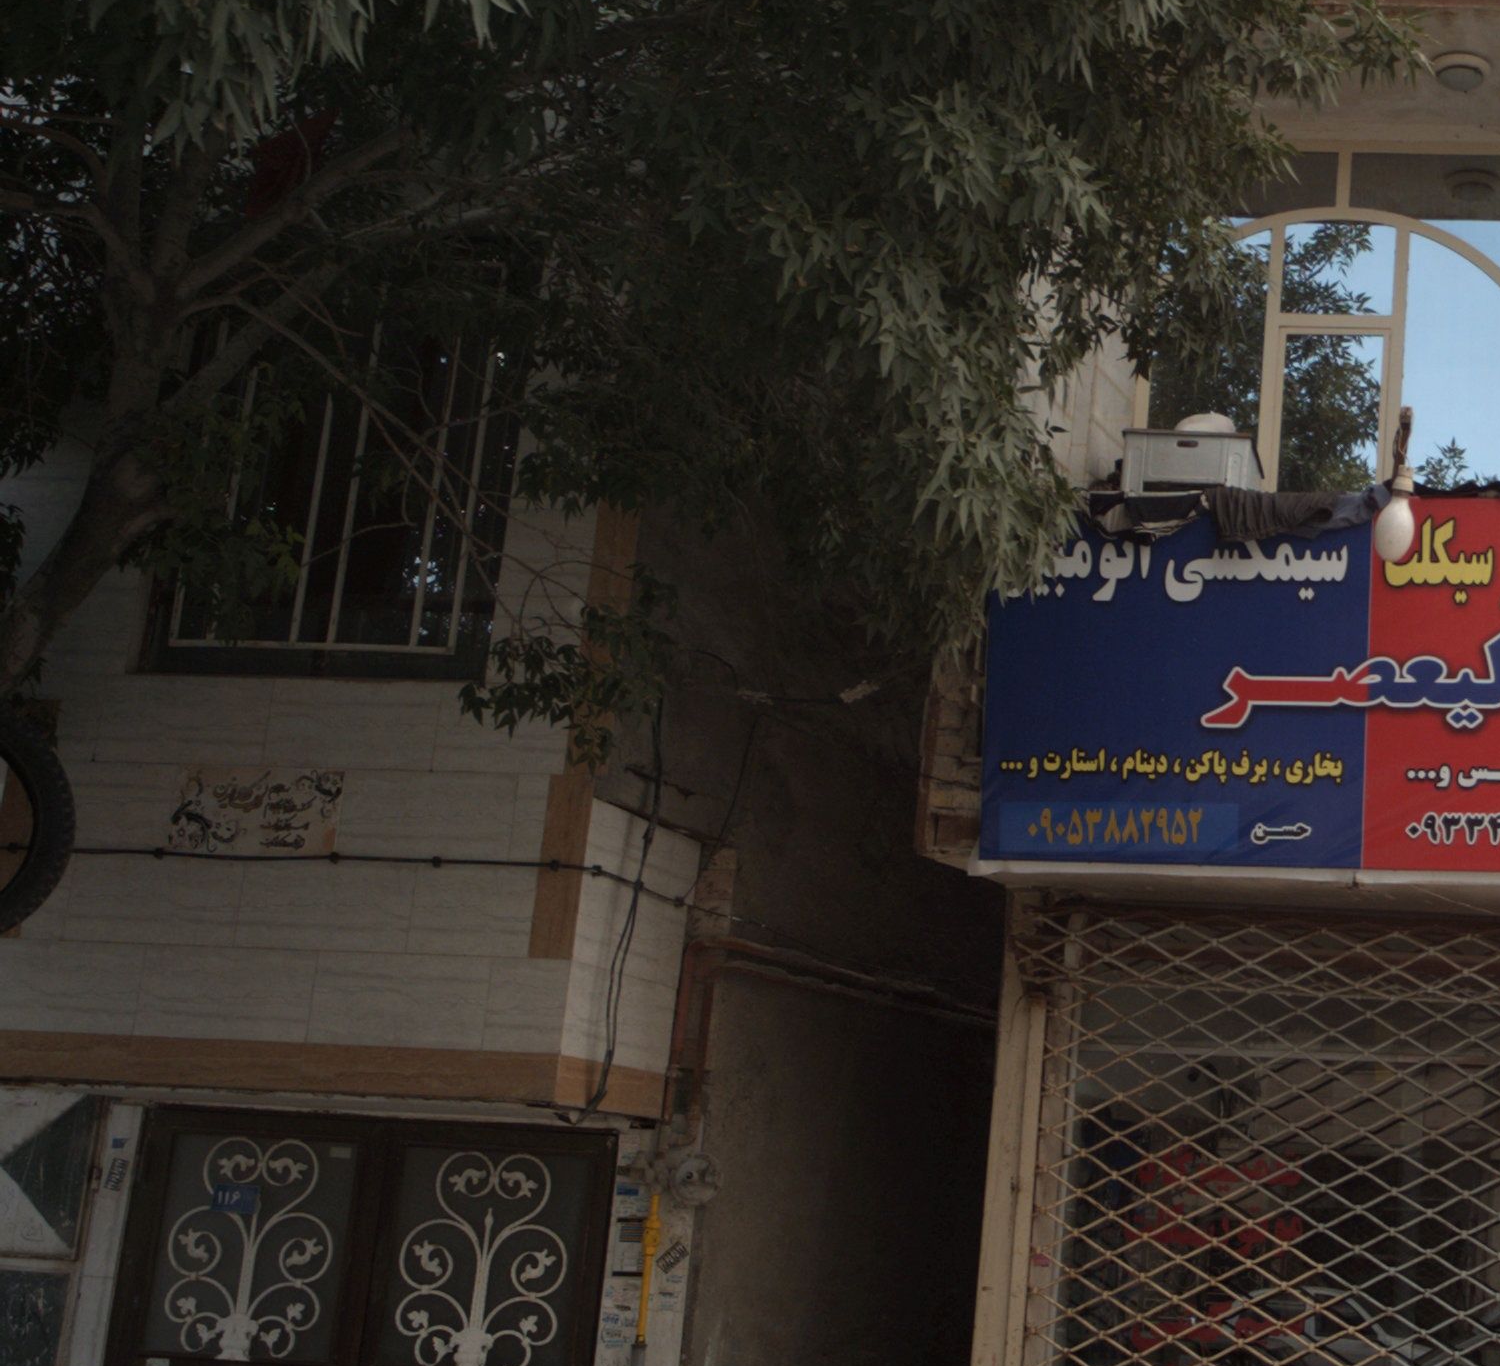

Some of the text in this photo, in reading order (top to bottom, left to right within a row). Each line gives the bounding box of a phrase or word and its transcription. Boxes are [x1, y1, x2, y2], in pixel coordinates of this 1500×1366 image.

[1042, 747, 1106, 780] استارت
[1121, 748, 1169, 780] دینام
[1184, 749, 1228, 783] پاکن
[1230, 749, 1268, 783] برف
[1284, 751, 1344, 785] بخاری
[1026, 807, 1312, 846] حسن ۰۹۰۵۳۸۸۲۹۵۲
